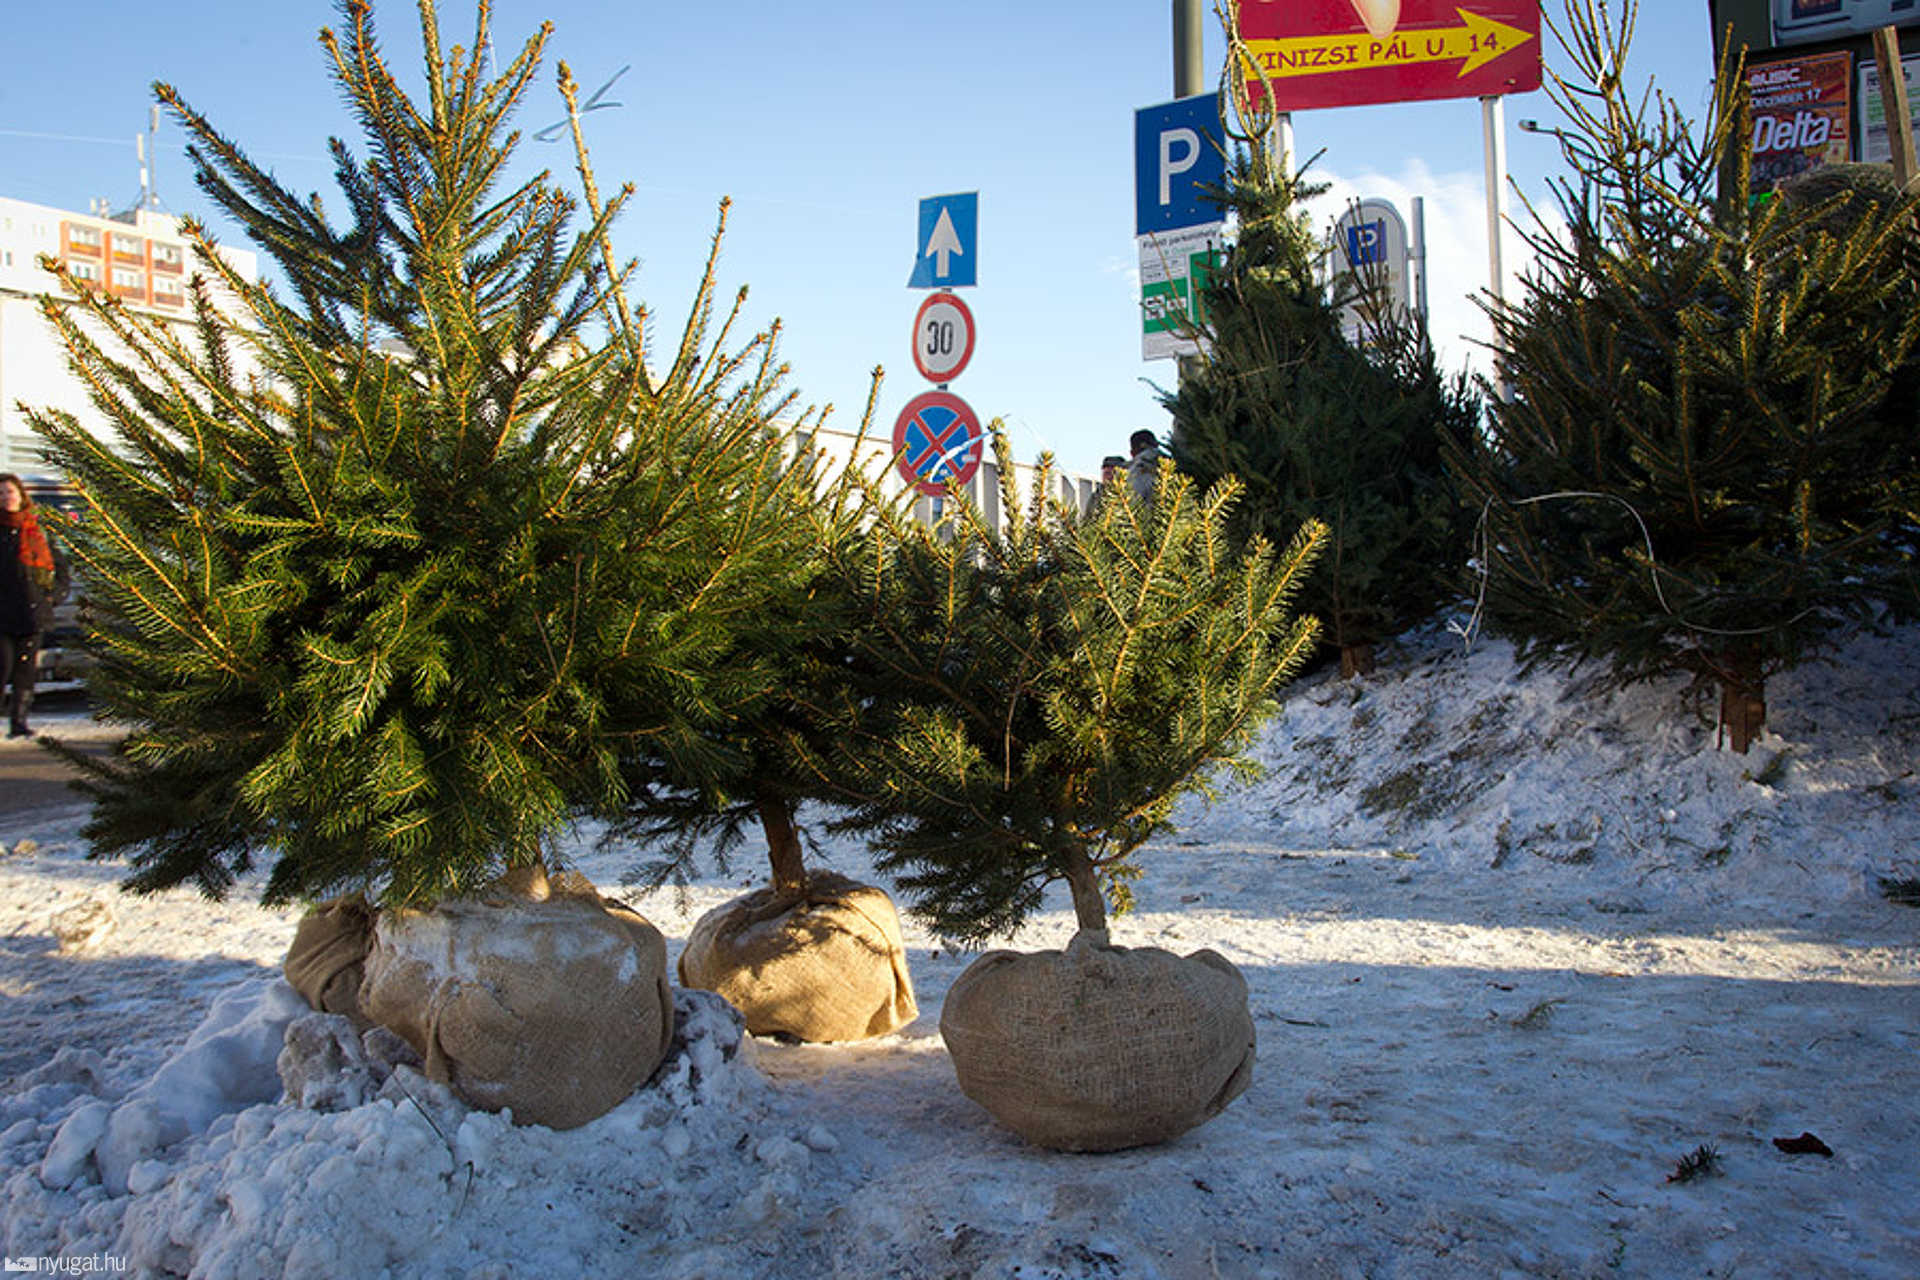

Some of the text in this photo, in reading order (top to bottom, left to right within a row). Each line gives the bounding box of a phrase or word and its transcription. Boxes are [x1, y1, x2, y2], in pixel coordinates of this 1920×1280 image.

[1369, 35, 1416, 60] PÁL
[1426, 37, 1453, 56] U.
[1469, 32, 1506, 52] 14.
[1806, 87, 1822, 101] 17
[1752, 110, 1831, 153] Delta
[1159, 127, 1200, 206] P
[926, 320, 953, 355] 30
